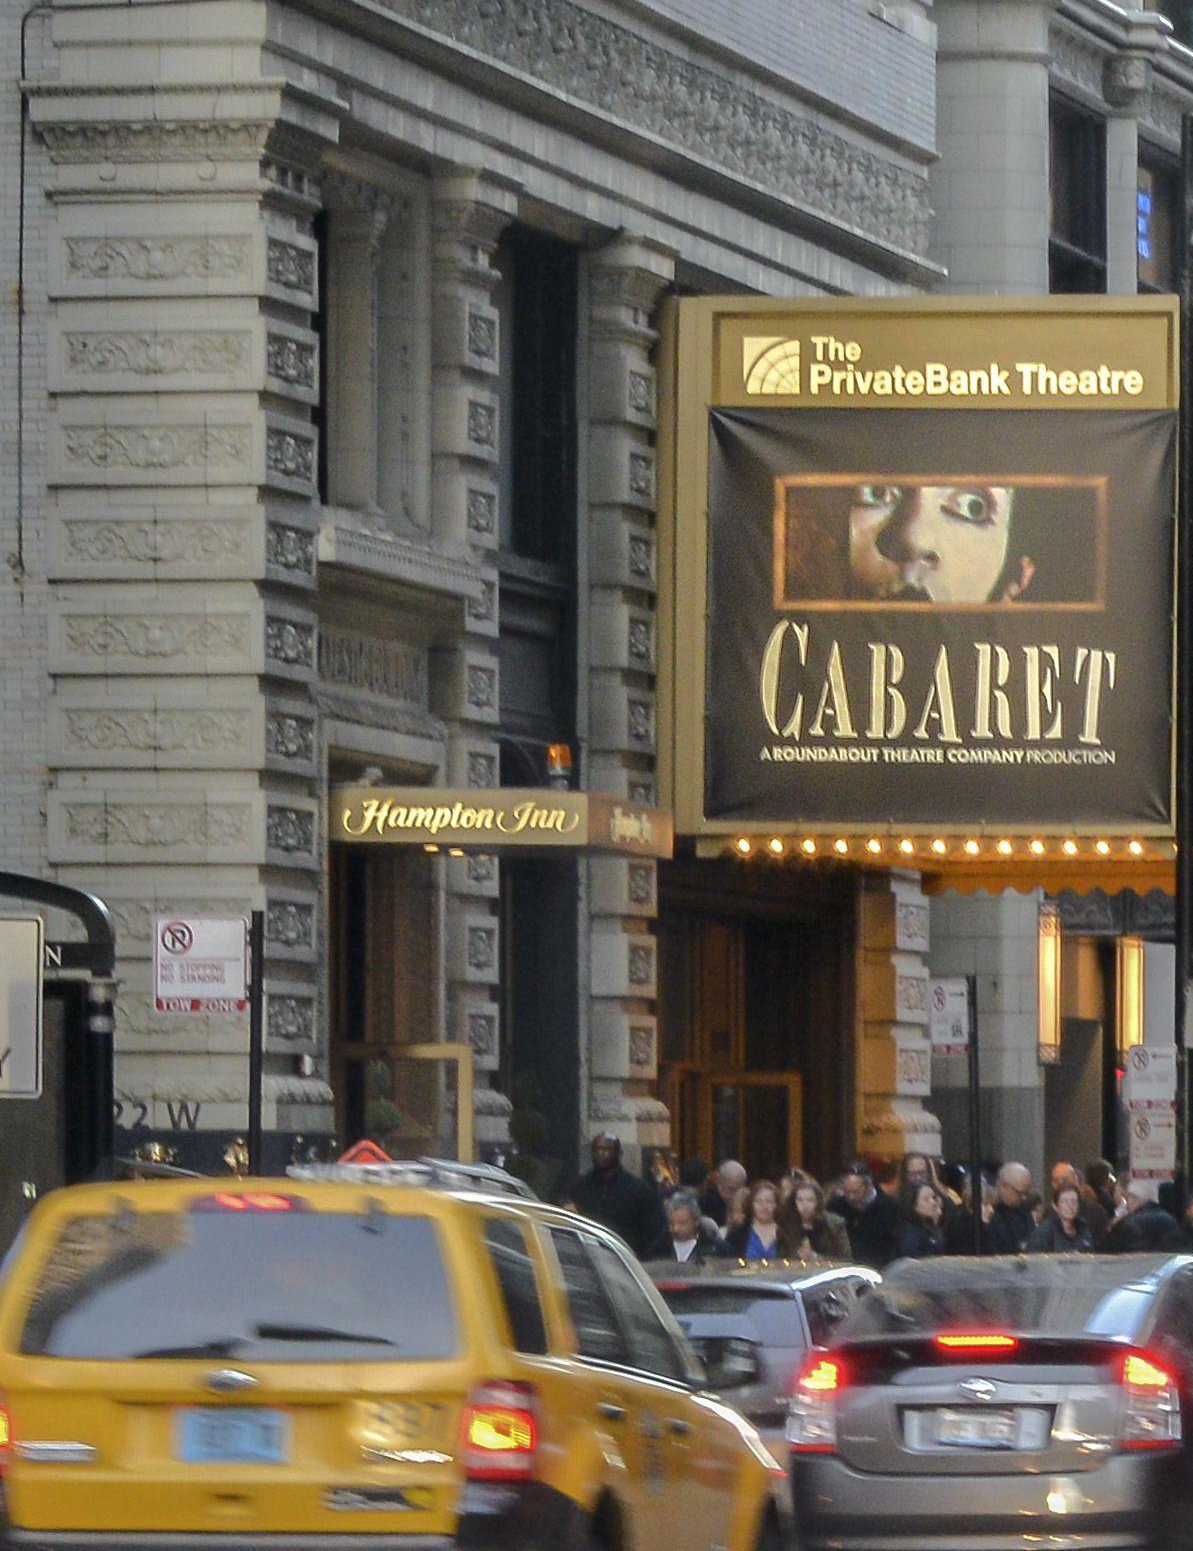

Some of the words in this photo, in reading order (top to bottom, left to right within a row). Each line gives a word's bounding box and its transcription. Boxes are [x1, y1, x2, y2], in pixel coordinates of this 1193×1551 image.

[810, 336, 862, 361] The
[810, 363, 1011, 395] PrivateBank
[1015, 363, 1144, 395] Theatre
[759, 619, 1116, 746] CABARET
[773, 747, 879, 763] ROUNDABOUT
[882, 748, 944, 763] THEATRE
[947, 749, 1024, 764] COMPANY
[1026, 750, 1116, 765] PRODUCTION
[342, 799, 496, 835] Hampton
[496, 801, 579, 834] Inn
[167, 1102, 200, 1131] W
